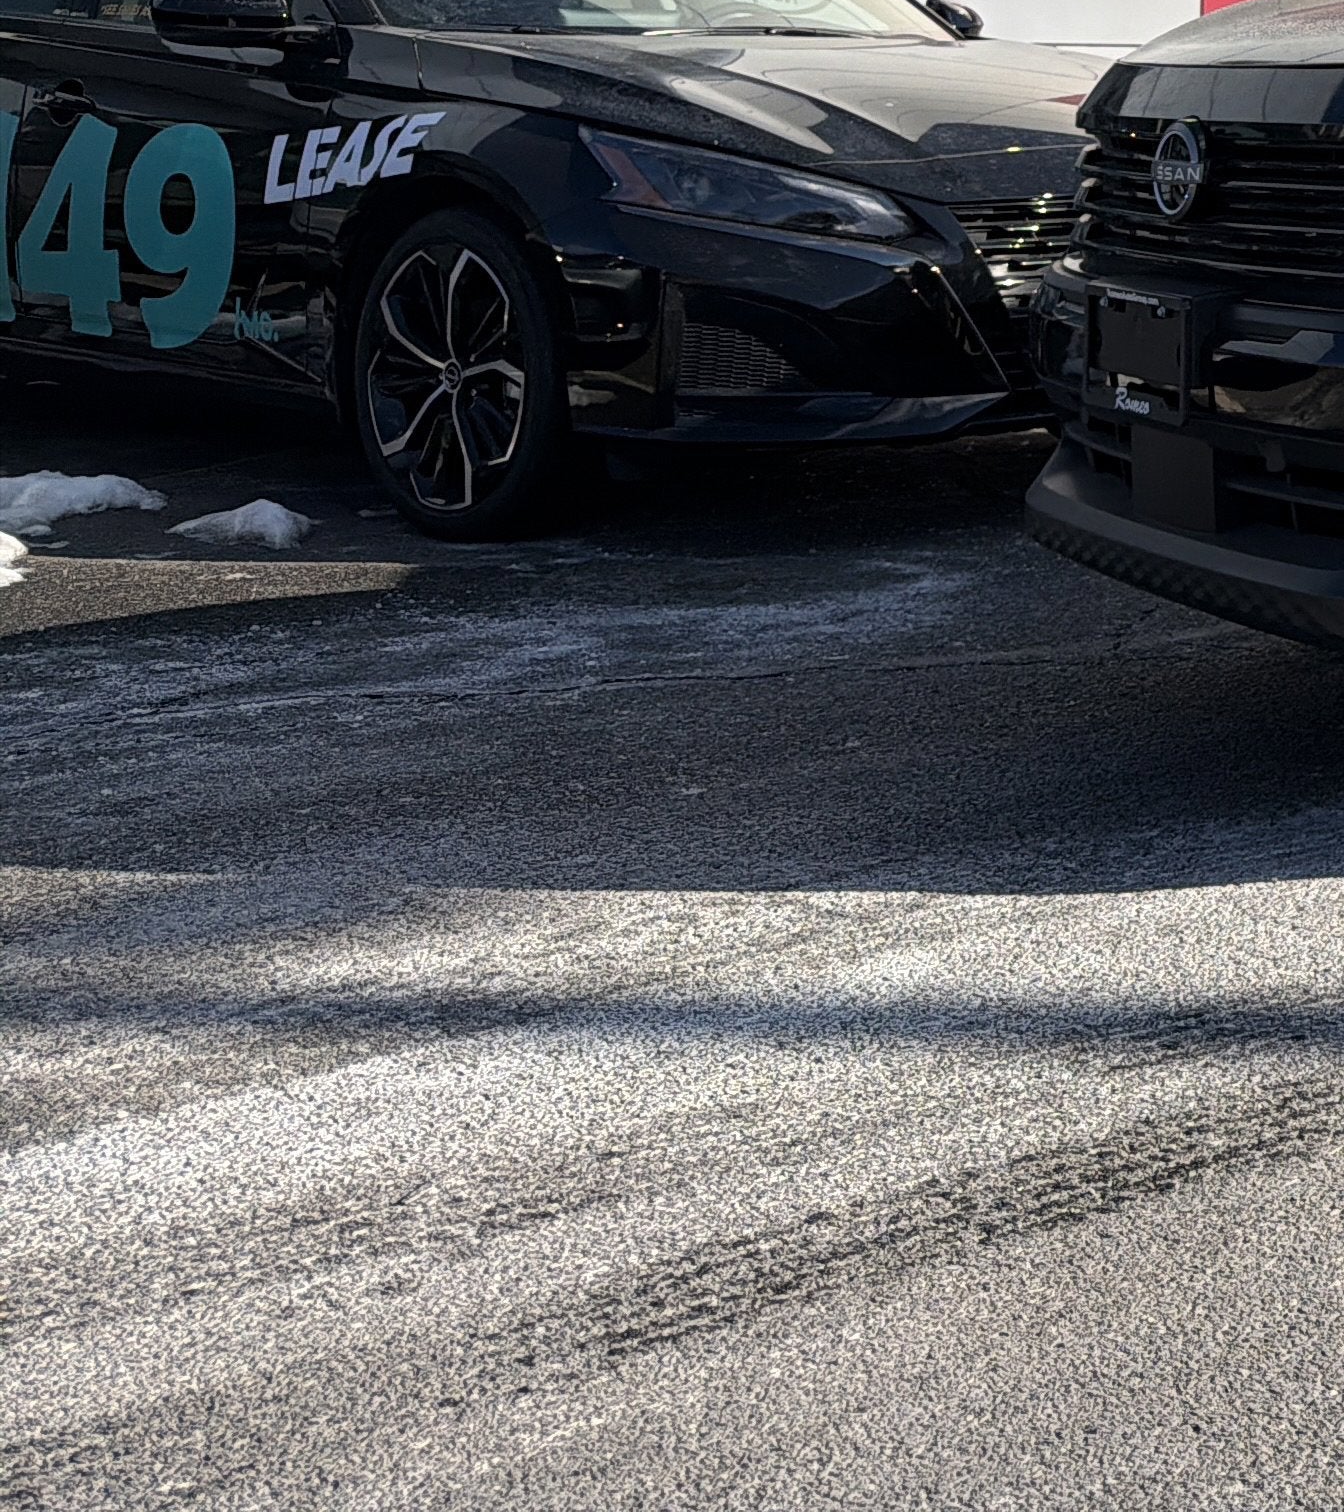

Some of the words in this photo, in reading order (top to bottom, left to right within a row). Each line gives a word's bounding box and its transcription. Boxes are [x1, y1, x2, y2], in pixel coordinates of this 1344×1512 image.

[263, 111, 447, 205] LEASE
[1156, 164, 1201, 182] SSAN
[1115, 386, 1150, 415] Romeo
